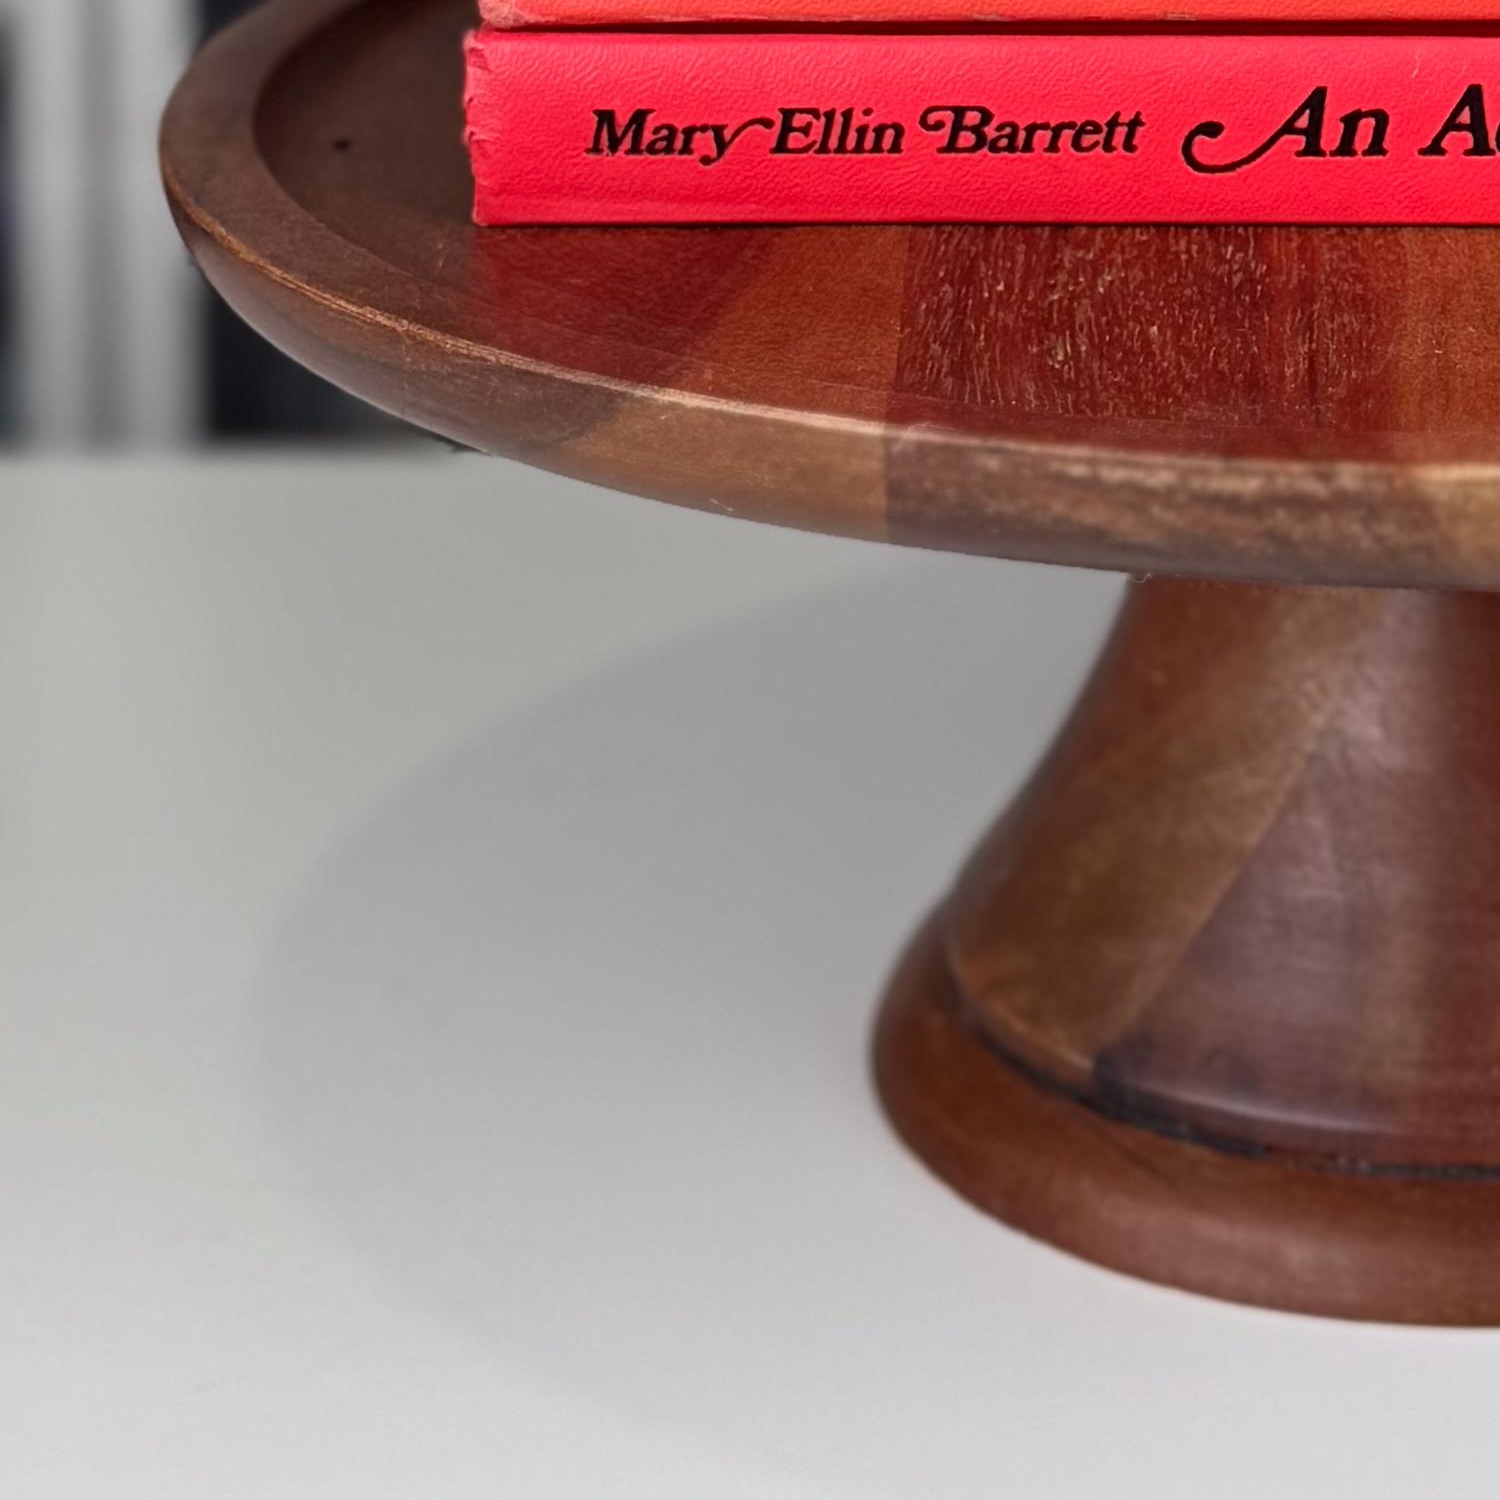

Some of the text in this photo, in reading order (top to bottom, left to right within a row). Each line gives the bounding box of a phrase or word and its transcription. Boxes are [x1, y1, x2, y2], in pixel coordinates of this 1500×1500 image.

[584, 104, 1147, 166] Mary Ellin Barrett
[1180, 84, 1390, 175] An
